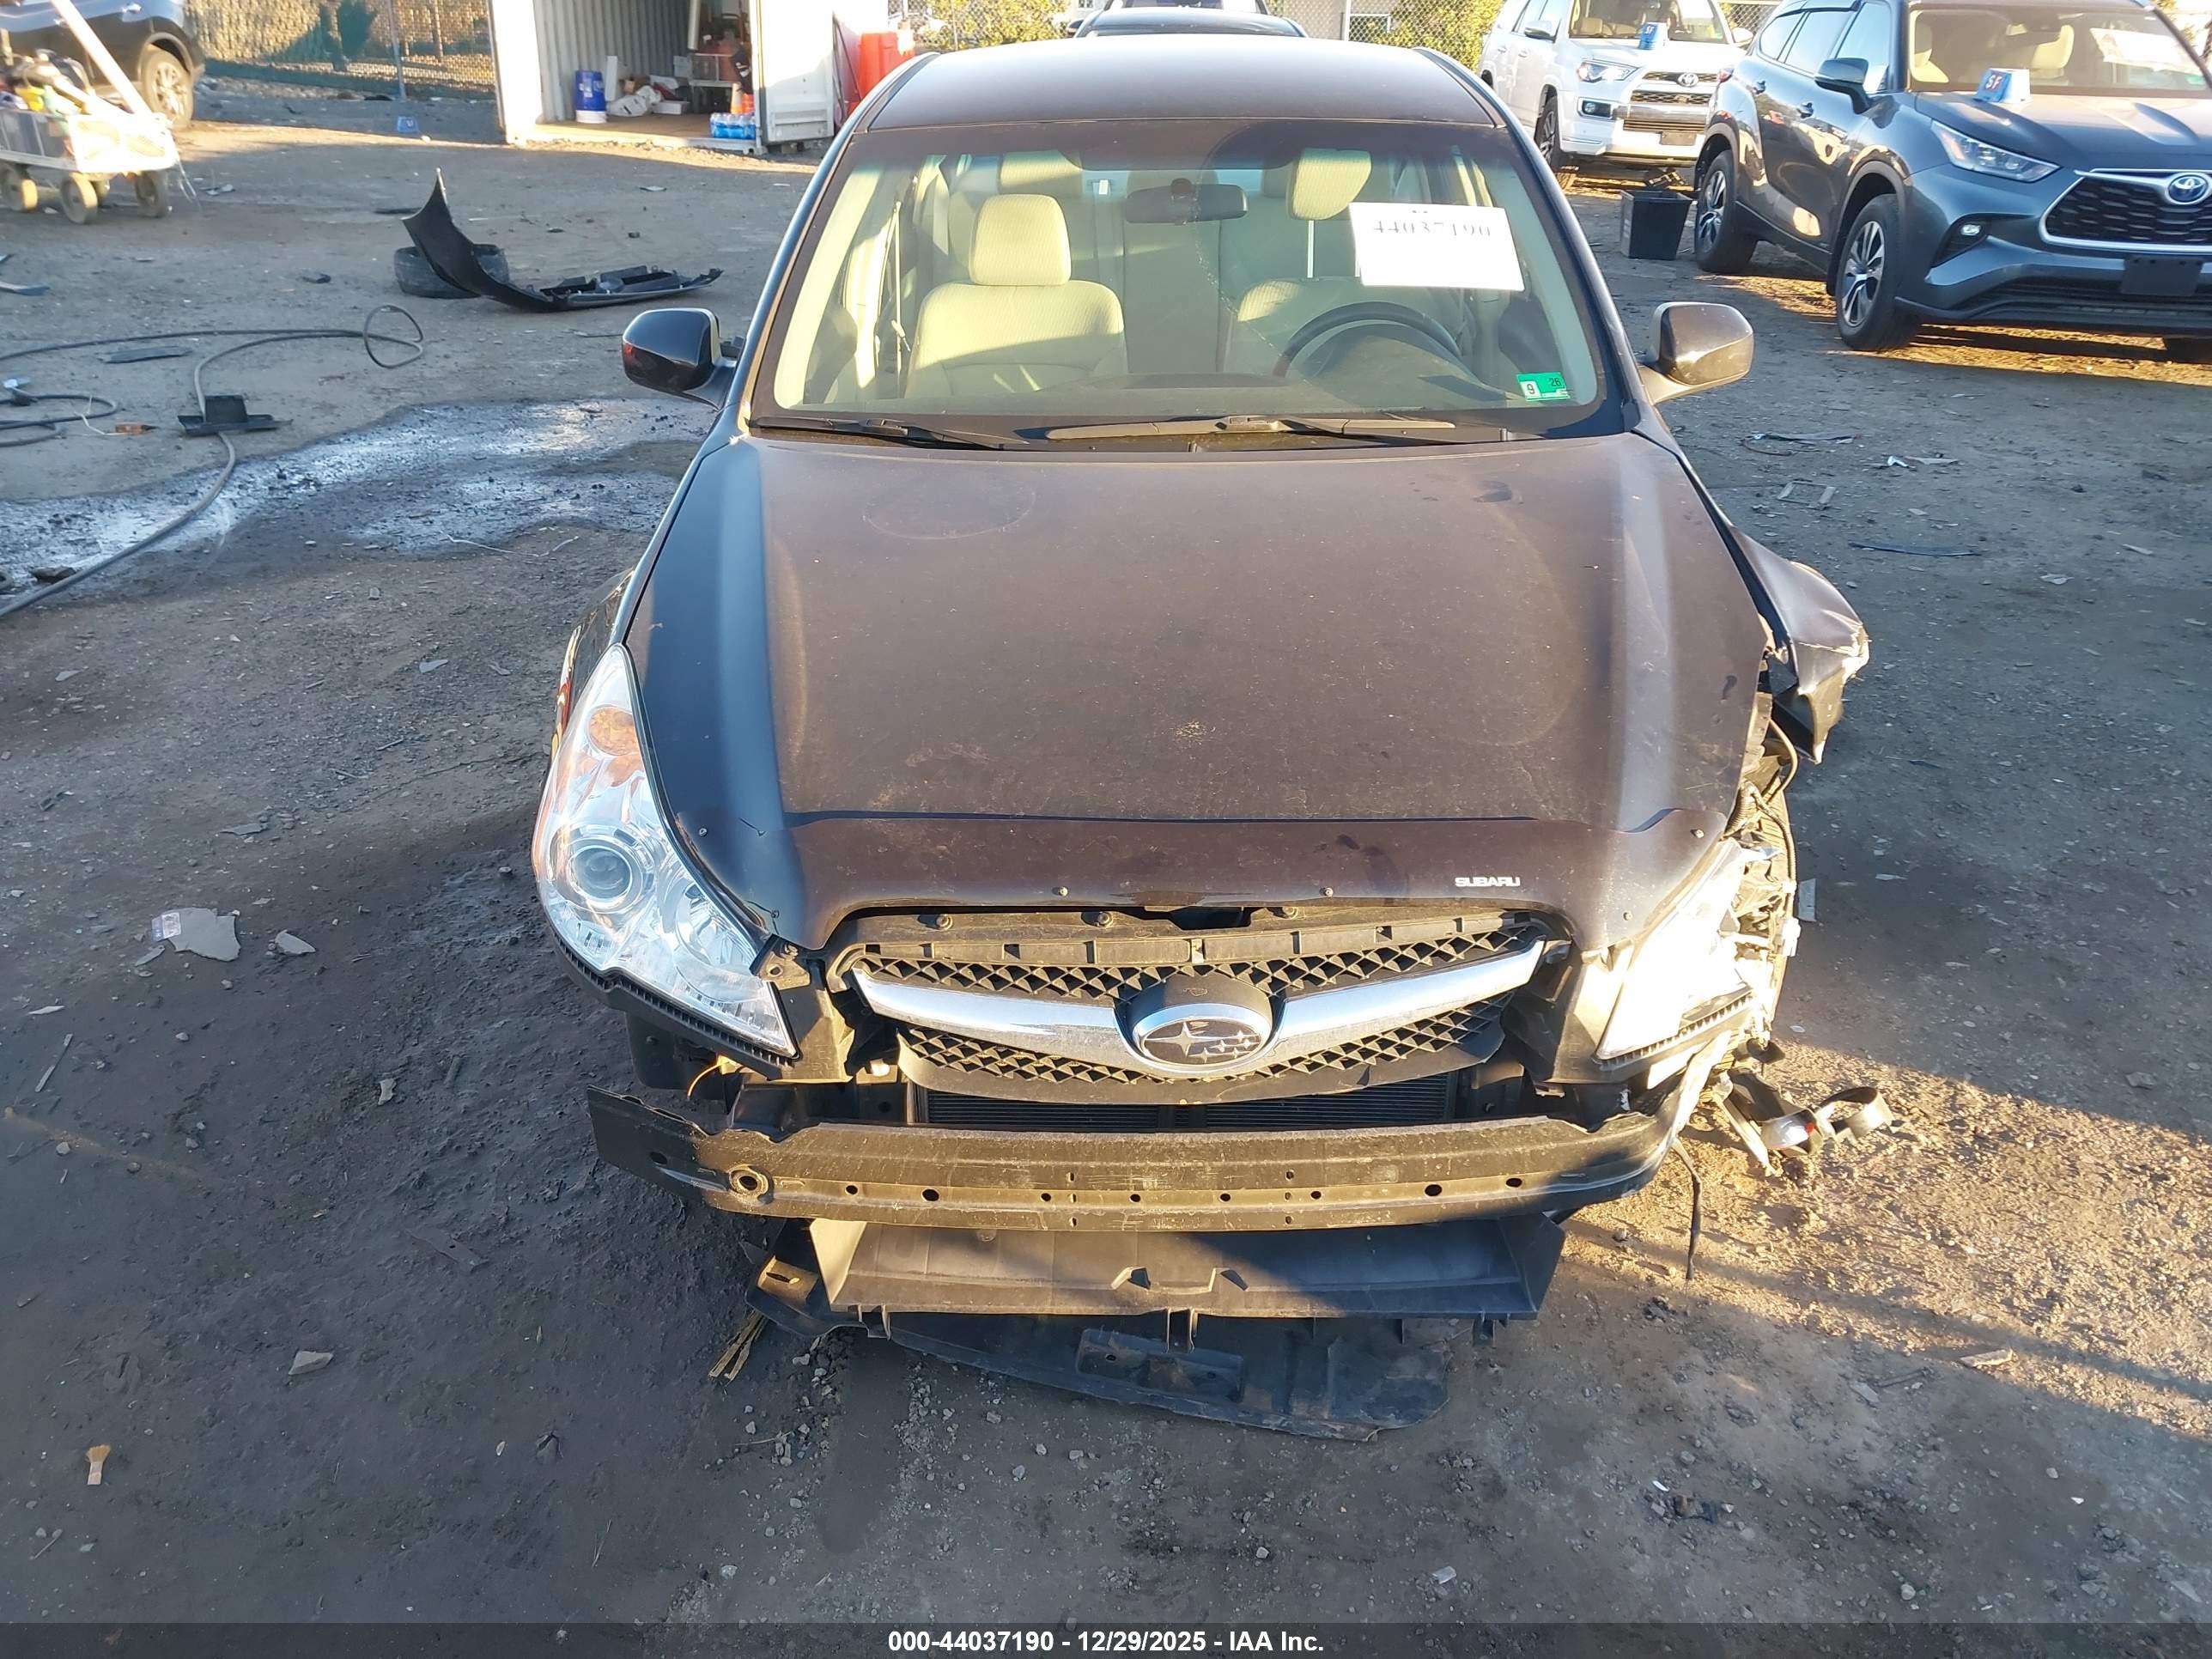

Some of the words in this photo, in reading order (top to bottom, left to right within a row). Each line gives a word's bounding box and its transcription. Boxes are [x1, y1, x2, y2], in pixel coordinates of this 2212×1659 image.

[1984, 74, 2002, 89] SF
[1548, 377, 1563, 387] 26
[1526, 383, 1535, 395] 9
[1455, 876, 1521, 887] SUBARU
